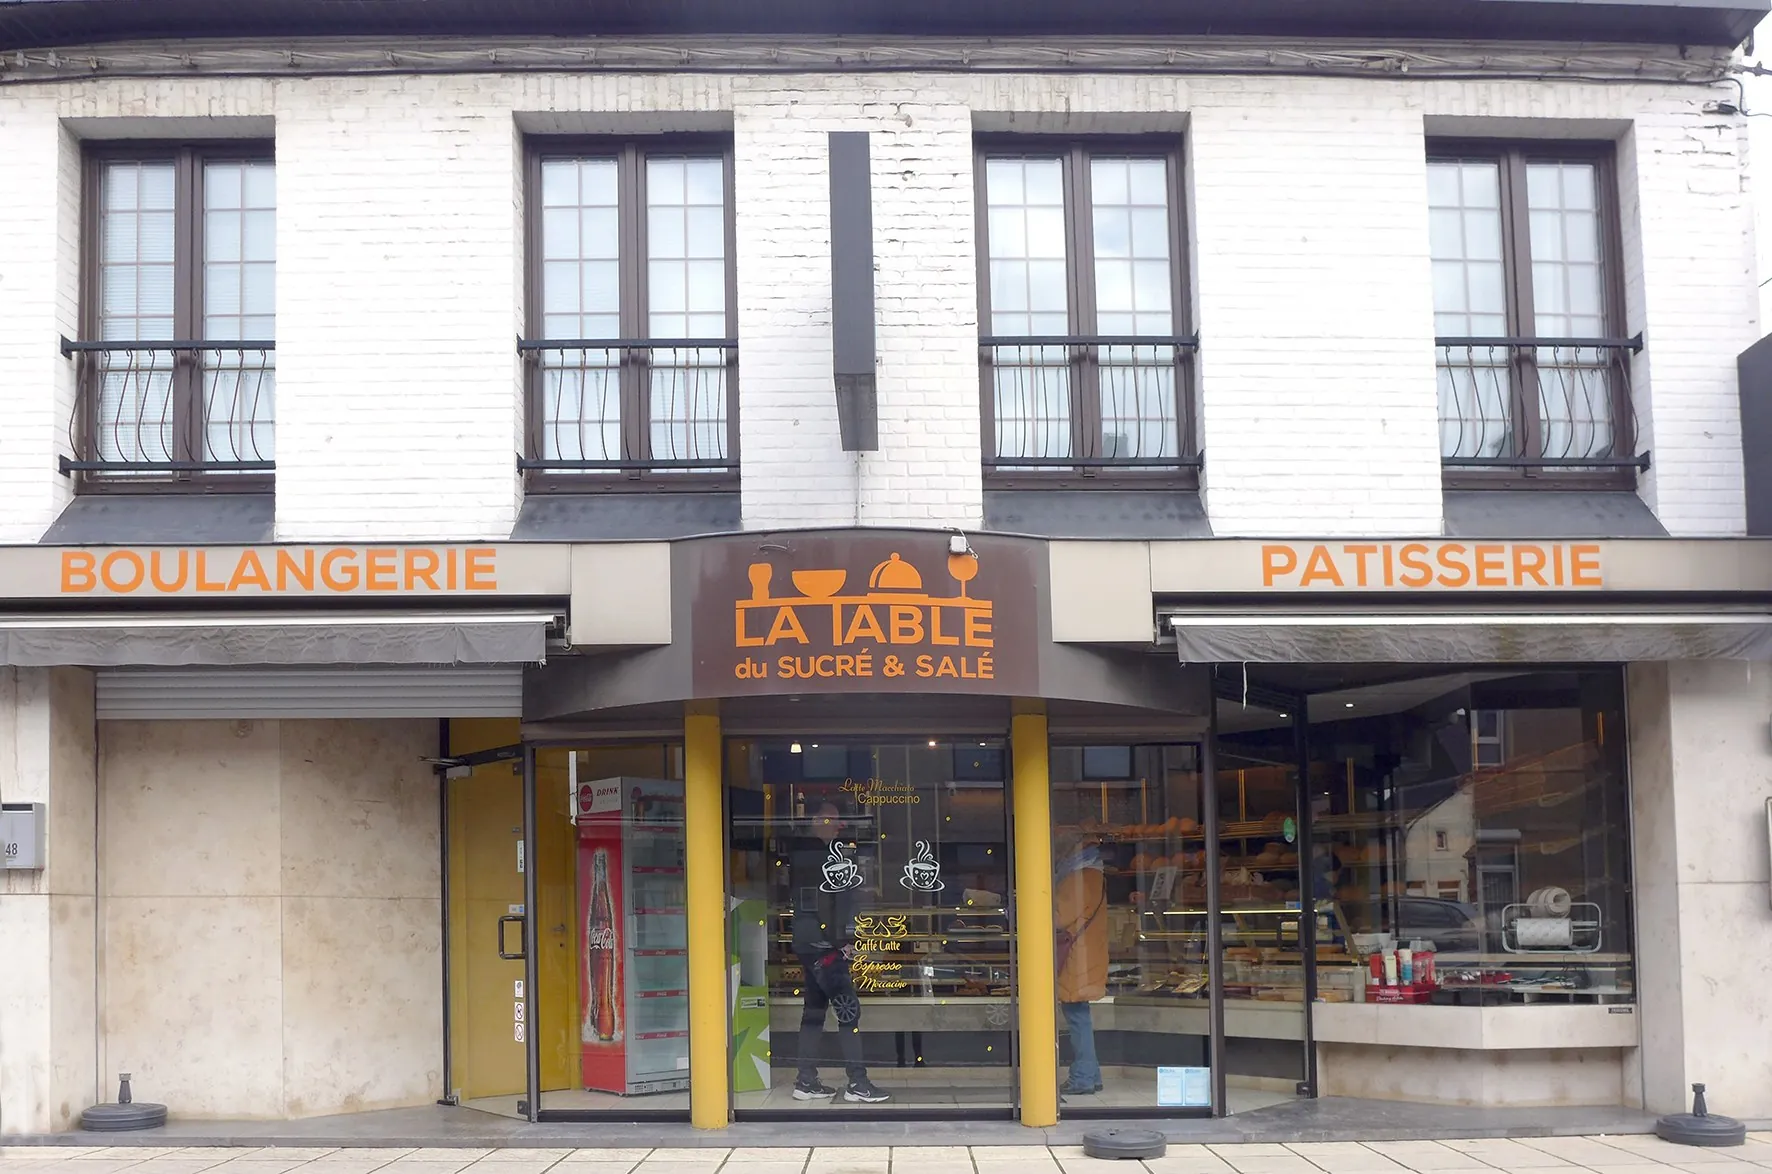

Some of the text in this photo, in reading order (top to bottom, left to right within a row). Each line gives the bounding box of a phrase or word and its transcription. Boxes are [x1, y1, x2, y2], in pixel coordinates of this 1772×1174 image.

[61, 548, 497, 593] BOULANGERIE
[1262, 543, 1602, 588] PATISSERIE
[735, 603, 994, 648] LA TABLE
[735, 648, 994, 679] du SUCRÉ & SALÉ
[596, 786, 620, 798] DRINK
[867, 777, 915, 793] Macchiato
[857, 792, 920, 806] Cappuccino
[5, 842, 18, 856] 48
[879, 939, 901, 951] Latte
[852, 954, 903, 976] Espresso
